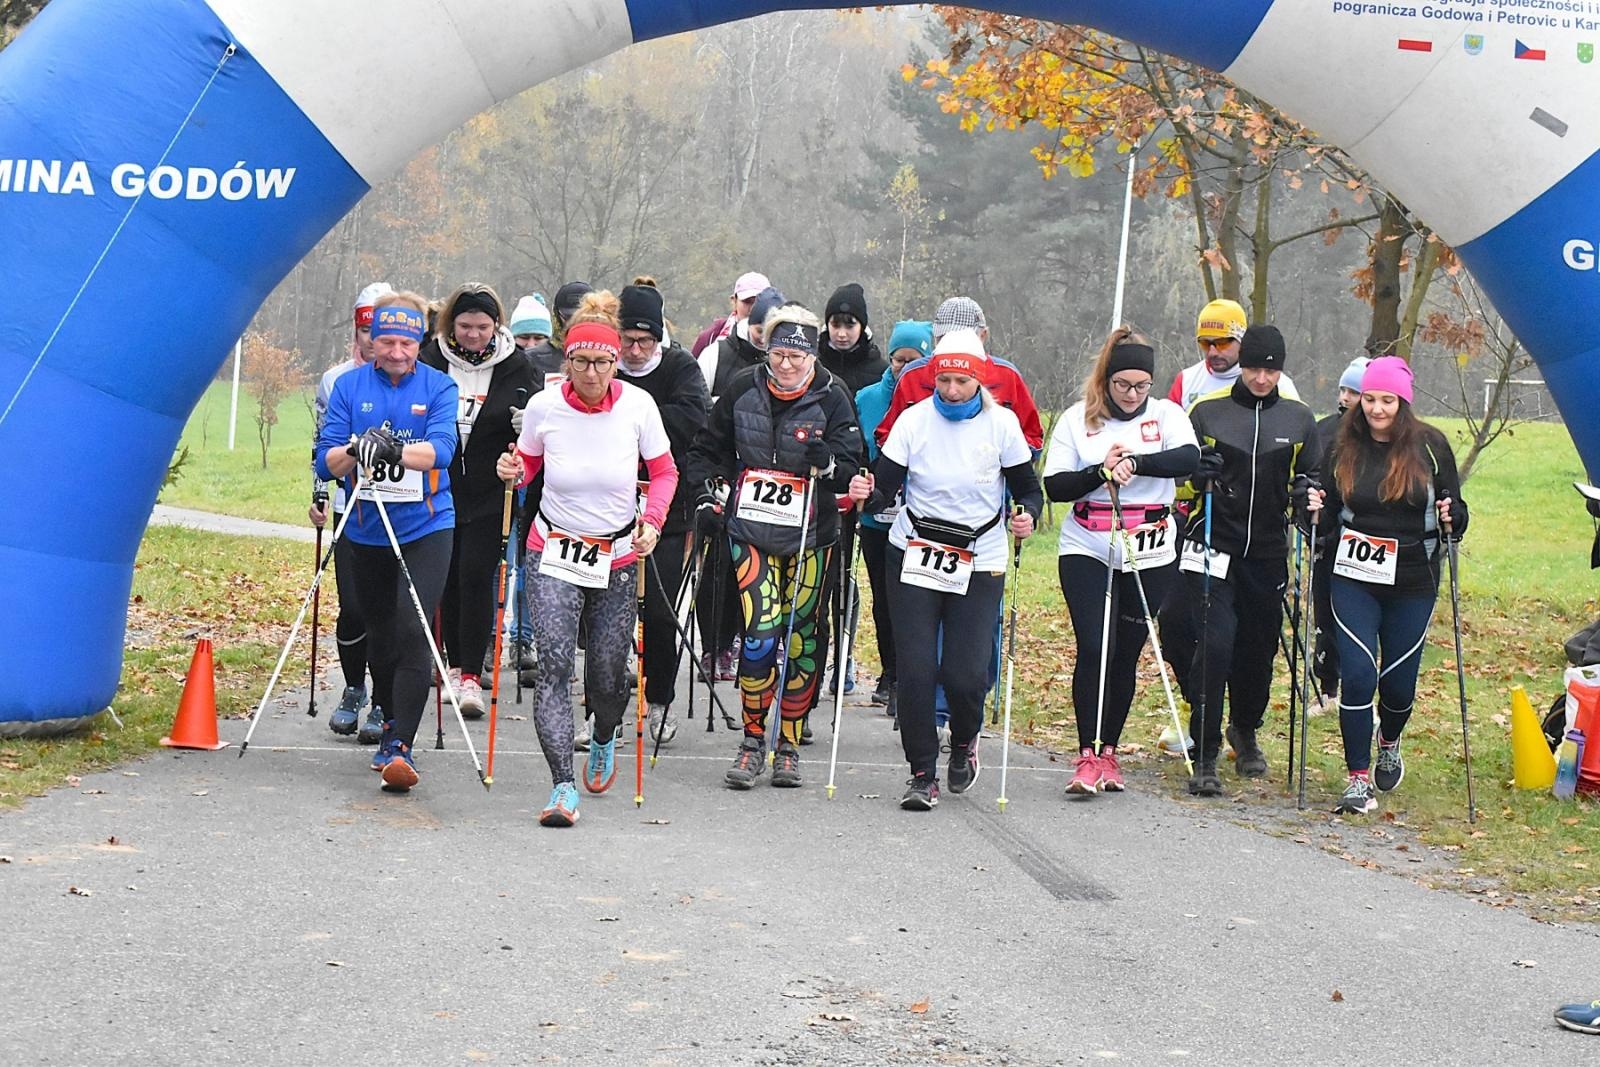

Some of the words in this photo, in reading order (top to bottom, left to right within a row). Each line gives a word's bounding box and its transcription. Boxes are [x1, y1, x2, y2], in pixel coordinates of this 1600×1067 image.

[1333, 1, 1417, 16] pogranicza
[1421, 5, 1483, 21] Godowa
[1489, 10, 1493, 22] i
[1497, 11, 1558, 27] Petrovic
[1562, 17, 1570, 28] u
[111, 160, 297, 200] GODÓW
[1563, 239, 1600, 273] G
[939, 358, 970, 370] POLSKA
[371, 459, 405, 483] 80
[753, 480, 793, 506] 128
[1135, 525, 1165, 552] 112
[1347, 538, 1387, 565] 104
[559, 538, 600, 567] 114
[921, 546, 960, 574] 113
